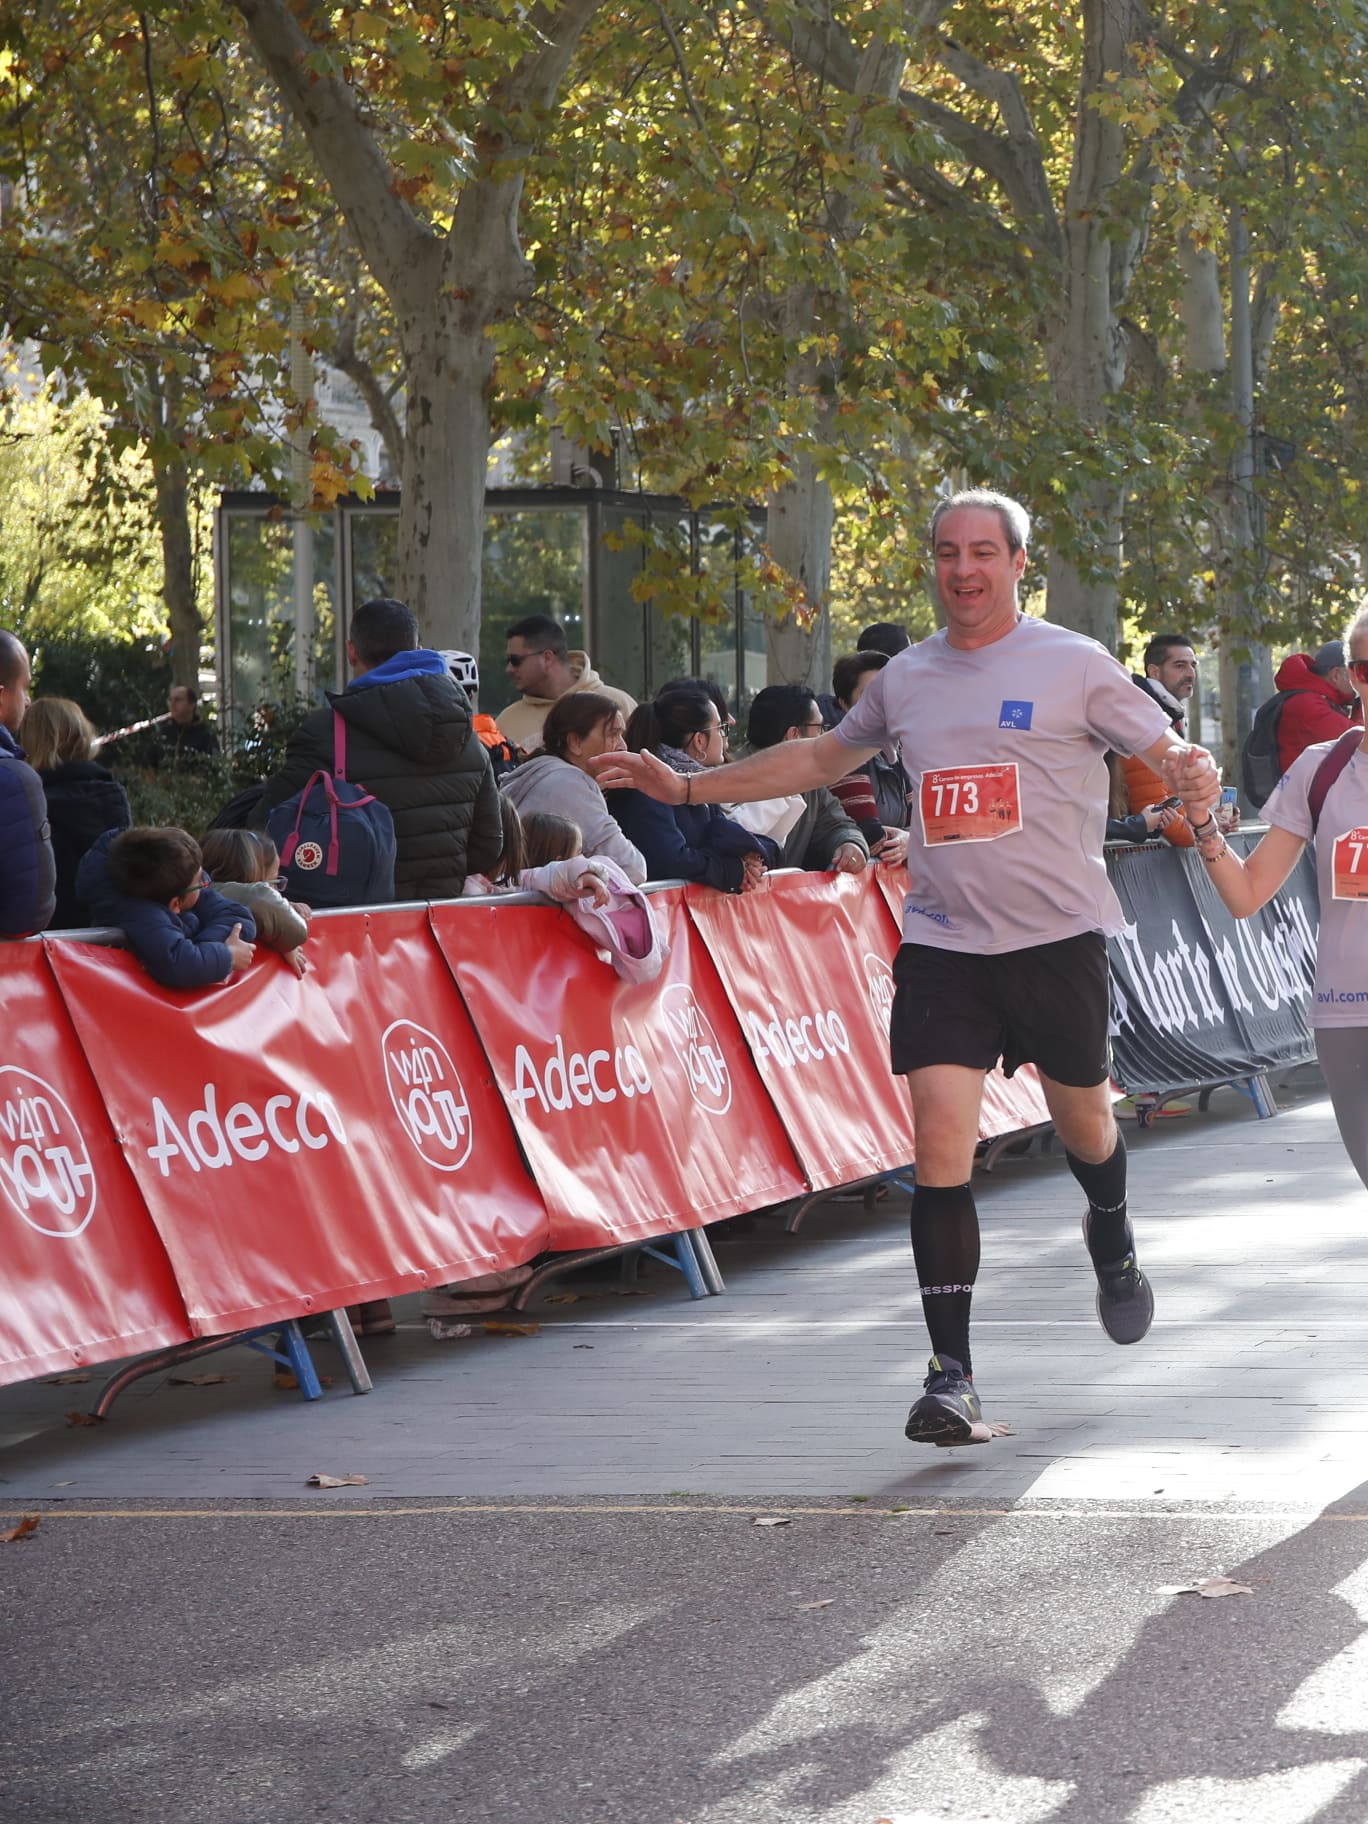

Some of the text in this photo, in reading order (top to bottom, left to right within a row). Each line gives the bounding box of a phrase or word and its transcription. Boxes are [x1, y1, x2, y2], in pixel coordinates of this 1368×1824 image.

[1000, 720, 1016, 728] AVL
[931, 782, 980, 817] 773
[747, 1003, 850, 1072] Adecco
[511, 1034, 652, 1117] Adecco
[147, 1083, 348, 1177] Adecco
